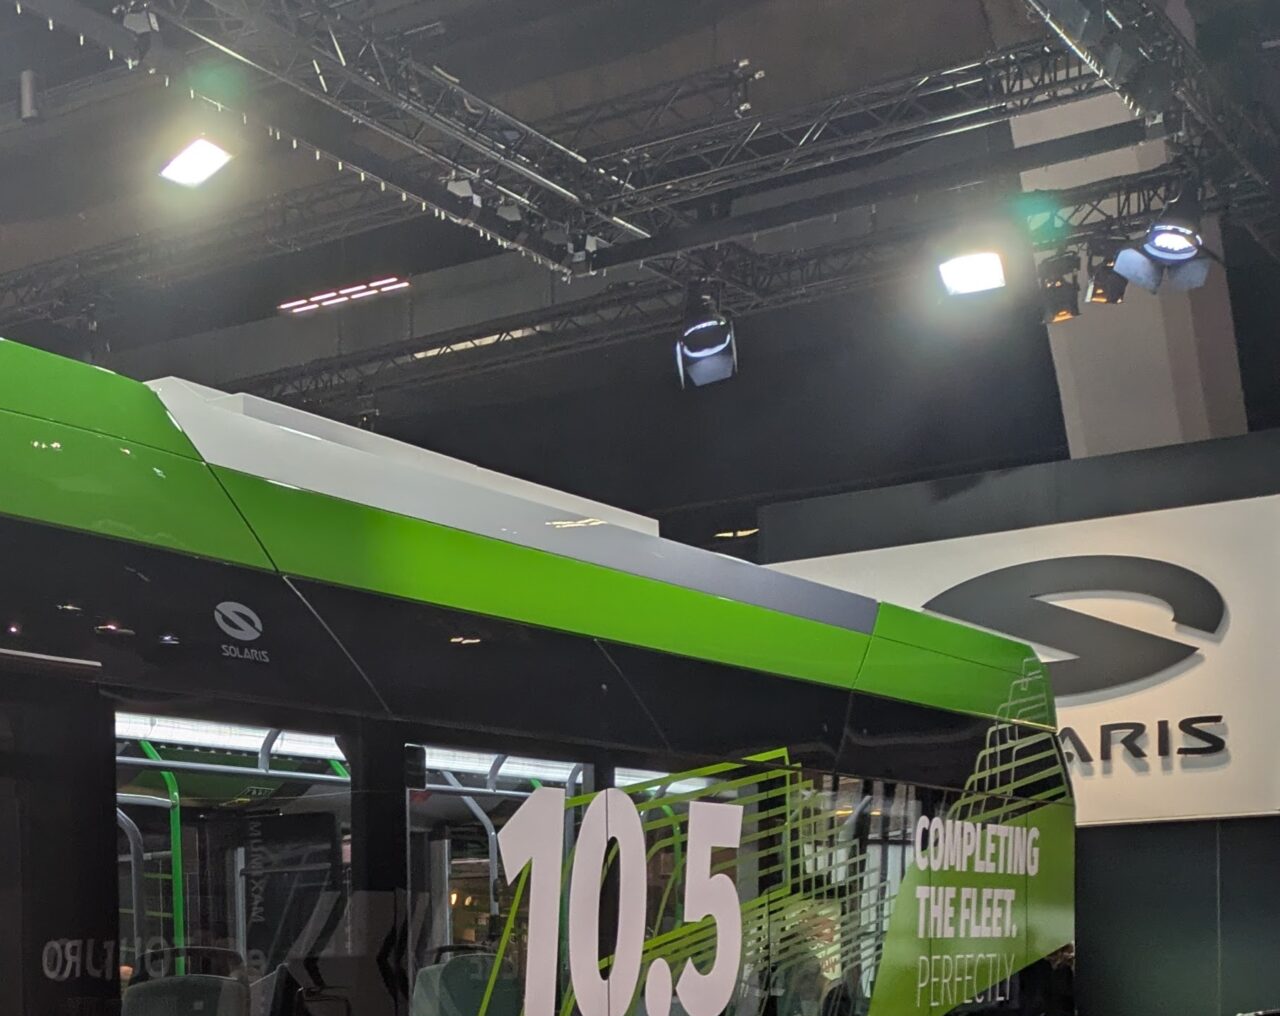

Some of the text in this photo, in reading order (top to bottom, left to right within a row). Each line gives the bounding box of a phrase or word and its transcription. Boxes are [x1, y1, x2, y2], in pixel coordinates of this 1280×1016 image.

[220, 644, 270, 663] SOLARIS
[915, 815, 1040, 876] COMPLETING
[916, 885, 1018, 939] THE FLEET.
[916, 952, 1016, 1008] PERFECTLY
